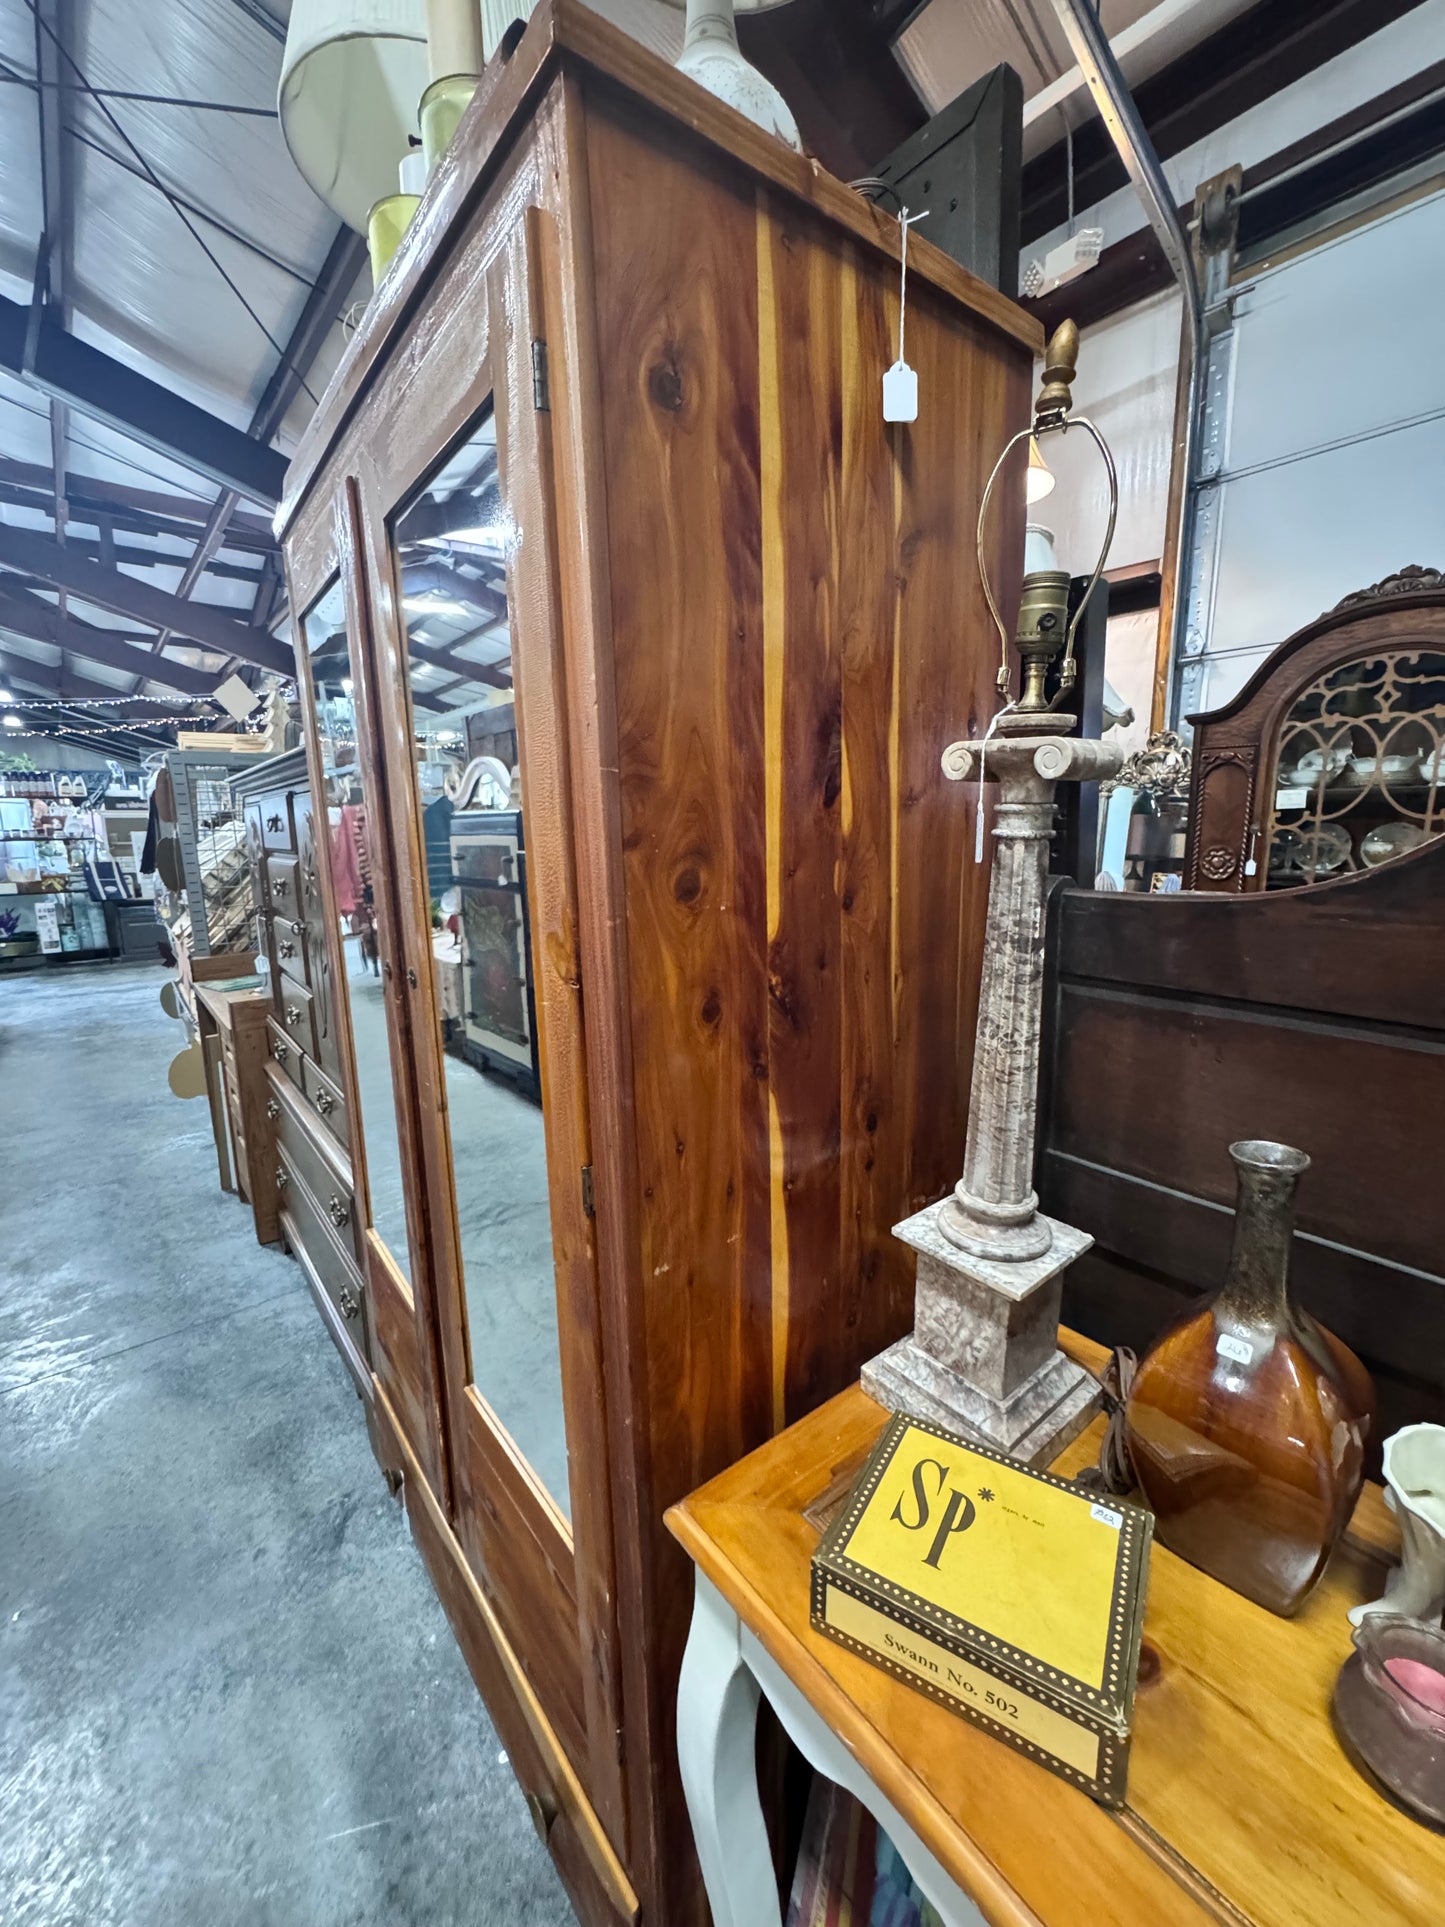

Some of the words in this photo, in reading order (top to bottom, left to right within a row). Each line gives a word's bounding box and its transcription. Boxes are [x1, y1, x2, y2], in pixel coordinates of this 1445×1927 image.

[884, 1633, 940, 1674] Swann
[947, 1667, 978, 1696] No.
[984, 1690, 1019, 1719] 502
